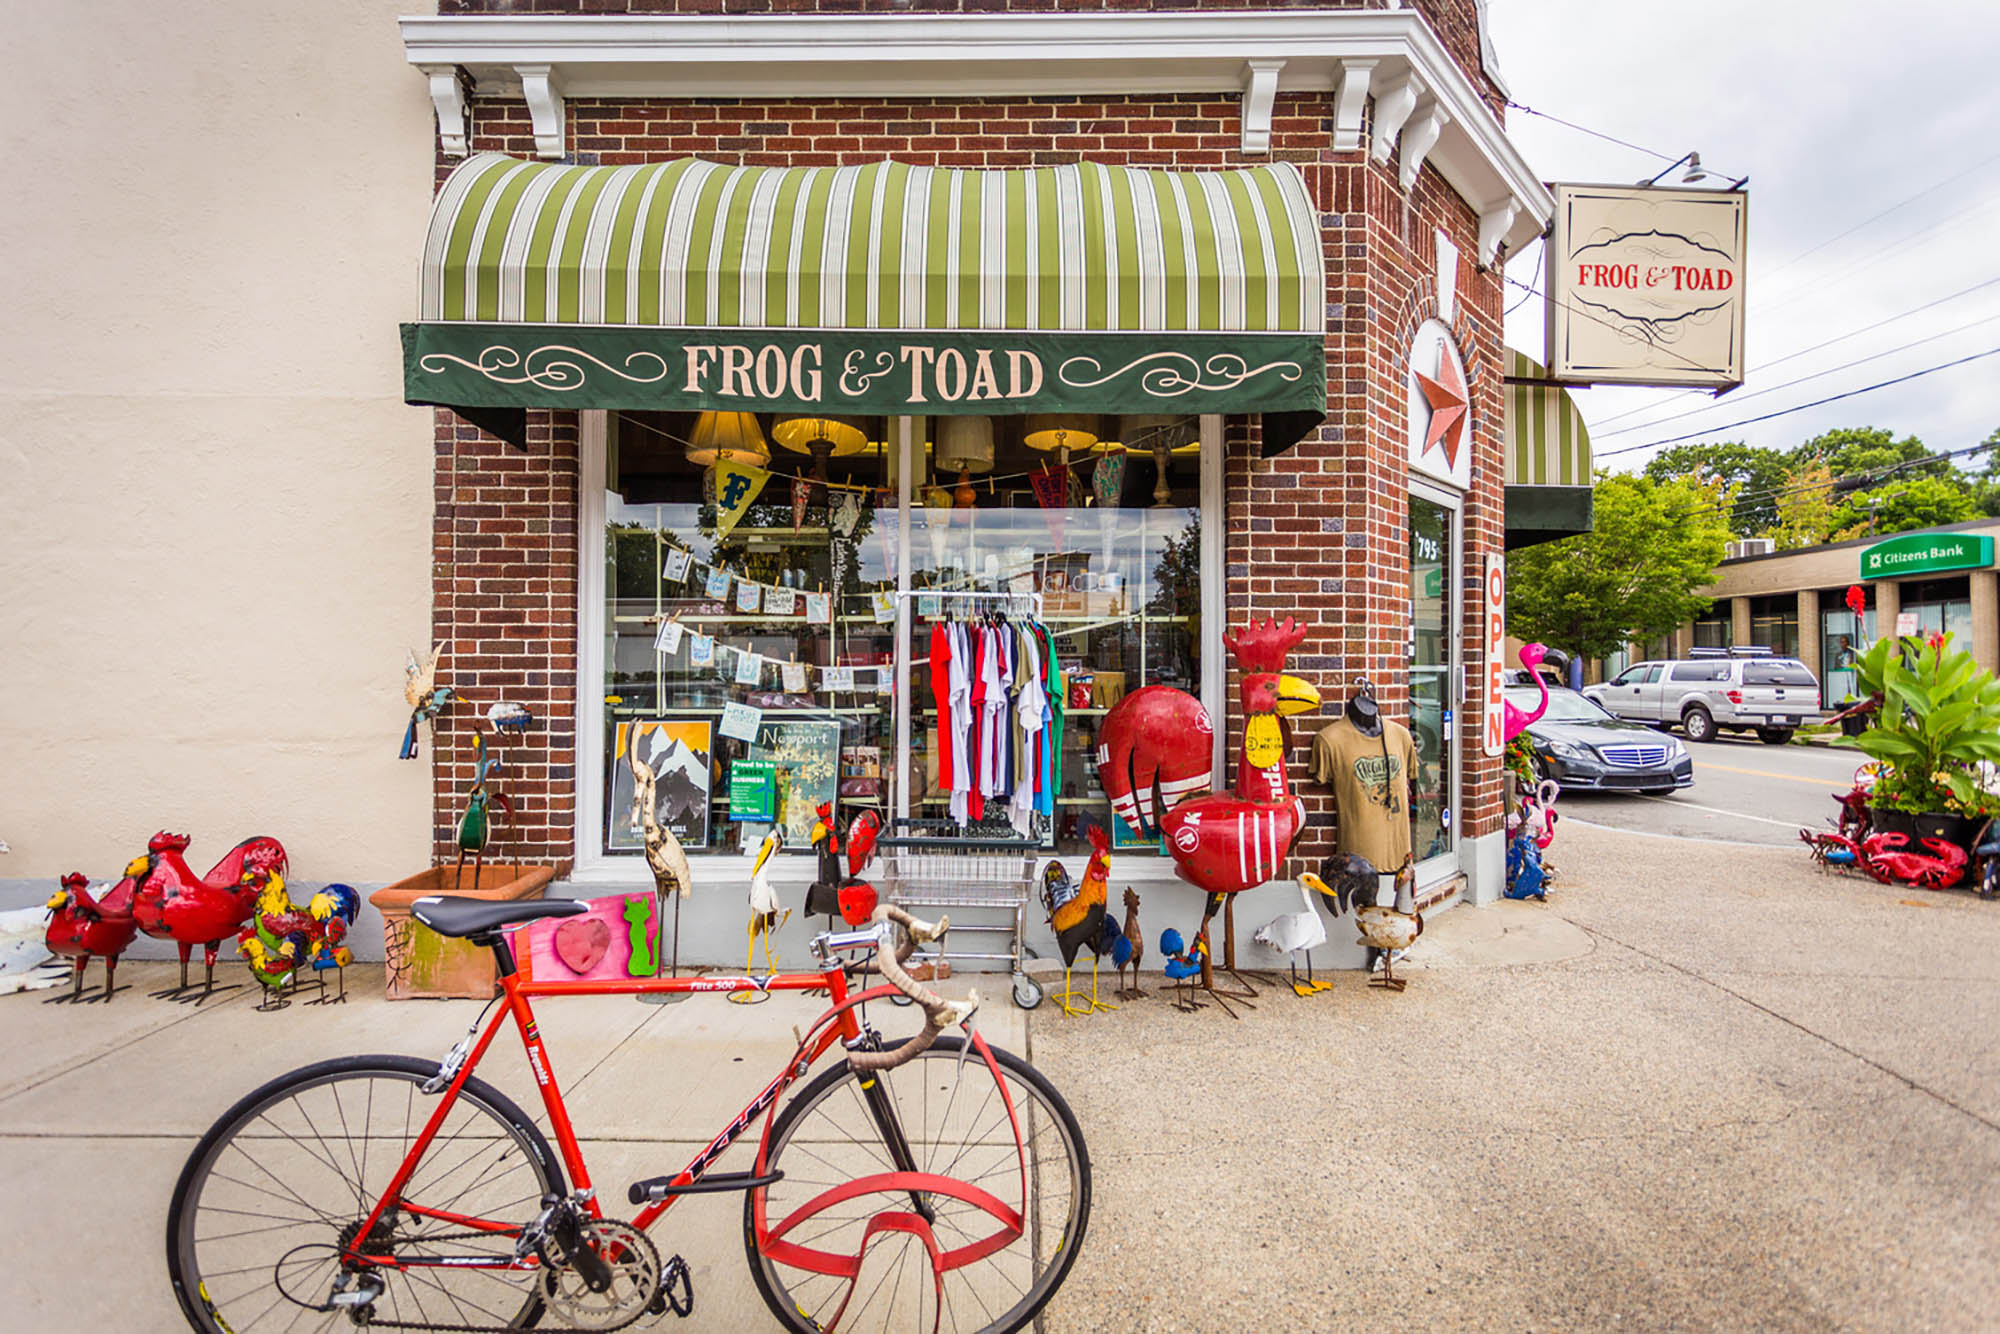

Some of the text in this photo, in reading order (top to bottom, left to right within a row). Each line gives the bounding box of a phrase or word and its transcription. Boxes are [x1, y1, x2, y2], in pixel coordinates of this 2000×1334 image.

[1578, 264, 1733, 291] FROG & TOAD
[682, 343, 1045, 403] FROG & TOAD
[1418, 537, 1438, 561] 795
[1884, 544, 1964, 564] Citizens Bank
[1488, 567, 1503, 748] OPEN
[762, 727, 830, 750] Newport
[715, 980, 737, 991] 500
